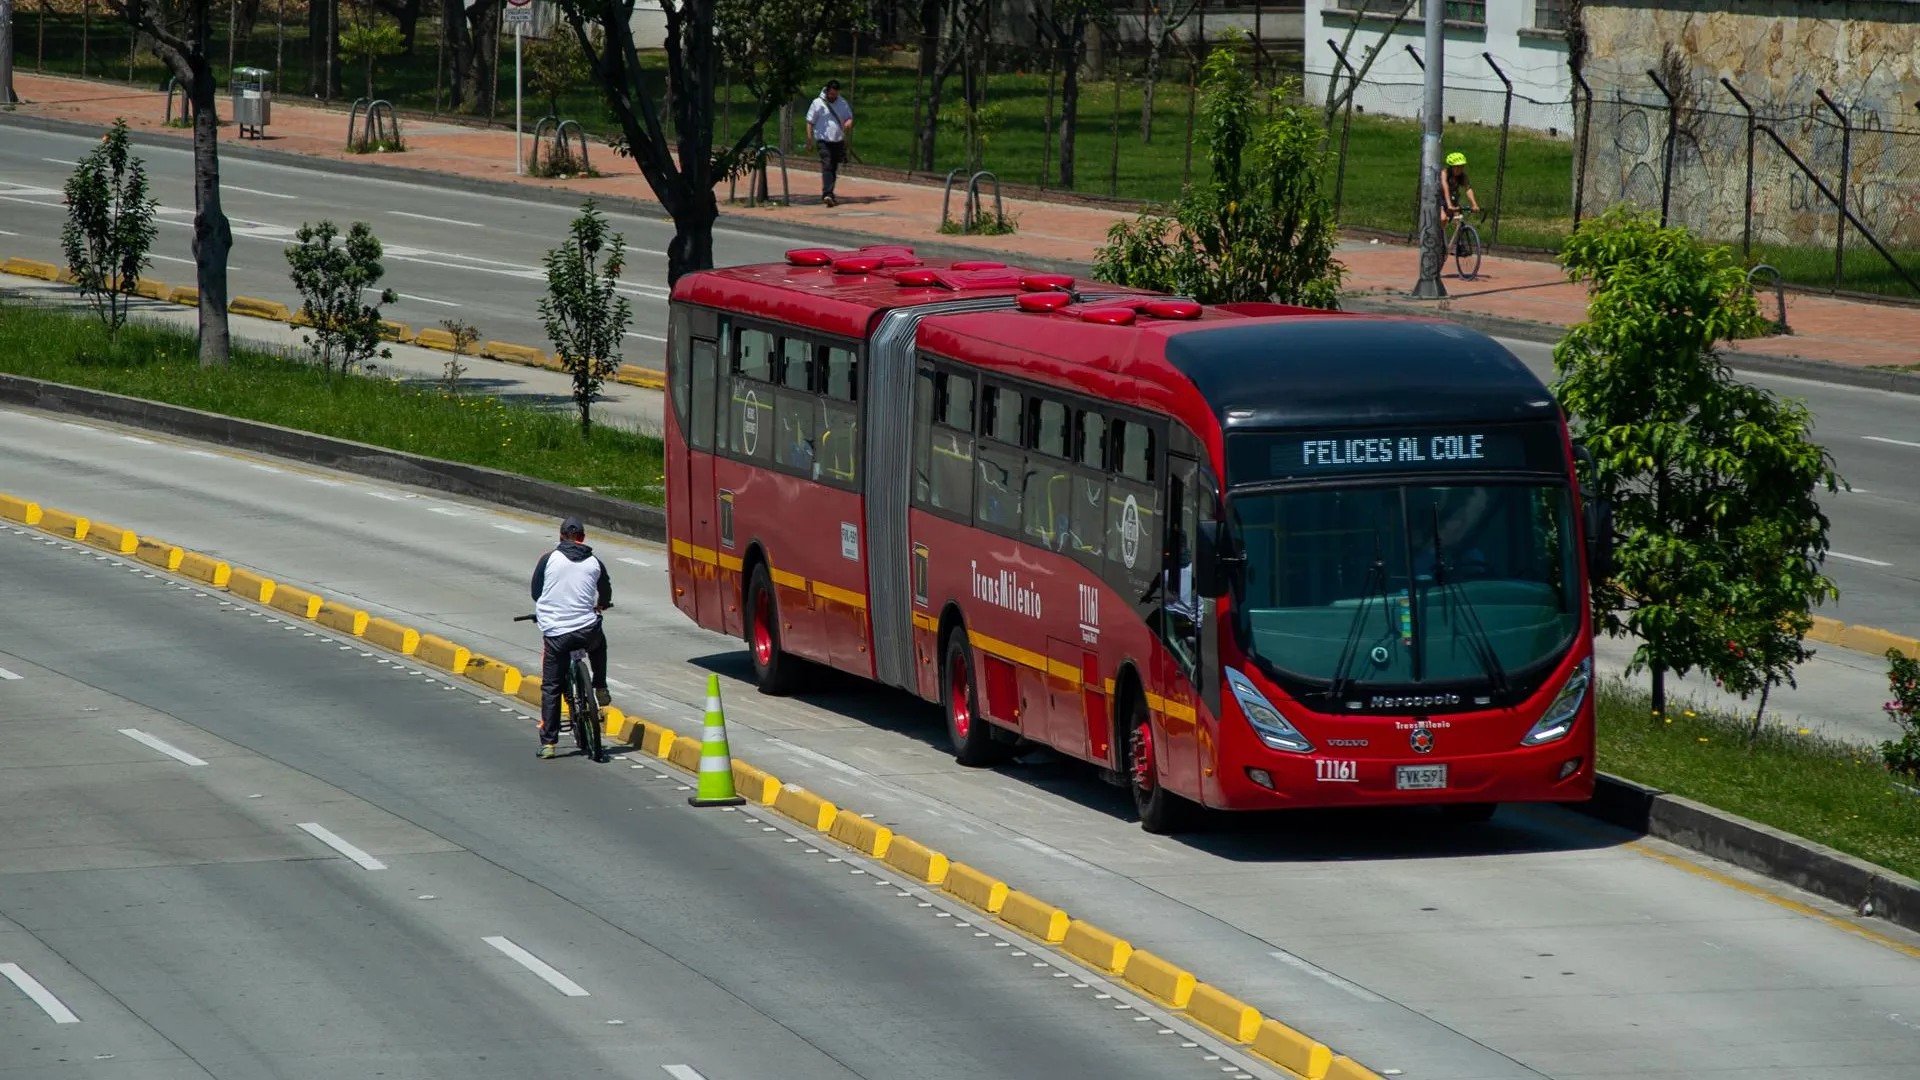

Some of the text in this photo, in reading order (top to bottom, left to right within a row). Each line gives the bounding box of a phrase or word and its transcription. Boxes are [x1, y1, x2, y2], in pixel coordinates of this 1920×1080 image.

[1303, 434, 1485, 464] FELICES AL COLE
[971, 560, 1042, 620] TransMilenio
[1079, 583, 1099, 626] T1161
[1370, 693, 1461, 708] Marcopolo
[1395, 720, 1451, 730] TransMilenio
[1326, 739, 1369, 747] VOLVO
[1315, 759, 1357, 780] T1161
[1398, 769, 1444, 783] FVK-591
